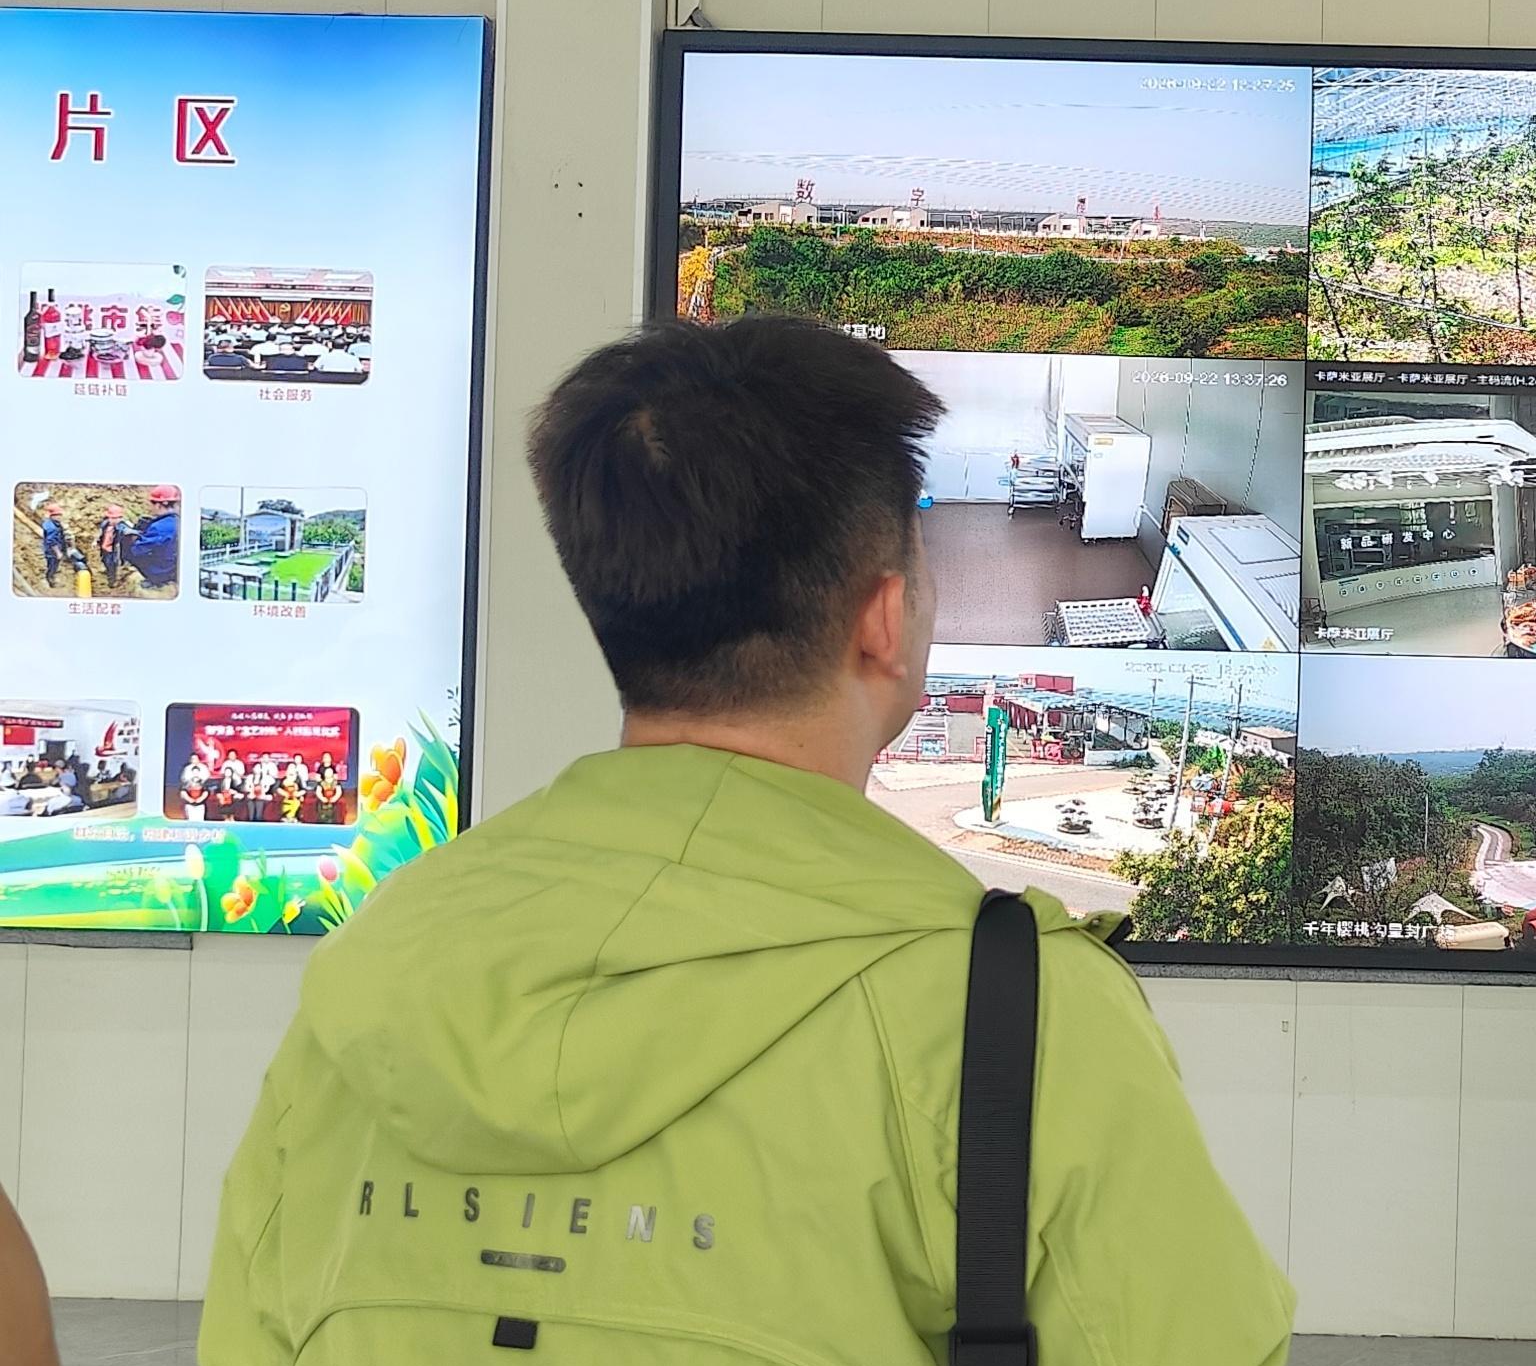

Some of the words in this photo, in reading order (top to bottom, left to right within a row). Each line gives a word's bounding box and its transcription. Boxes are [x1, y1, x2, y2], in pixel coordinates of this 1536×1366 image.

[48, 91, 238, 165] 片区
[1132, 371, 1218, 385] 2026-09-22
[1223, 373, 1288, 387] 13:37:26
[1314, 371, 1386, 383] 卡萨米亚展厅
[1397, 372, 1468, 385] 卡萨米亚展厅
[259, 388, 313, 402] 社会服务
[68, 602, 122, 615] 生活配套
[253, 605, 306, 618] 环境改善
[360, 1179, 716, 1250] RLSIENS
